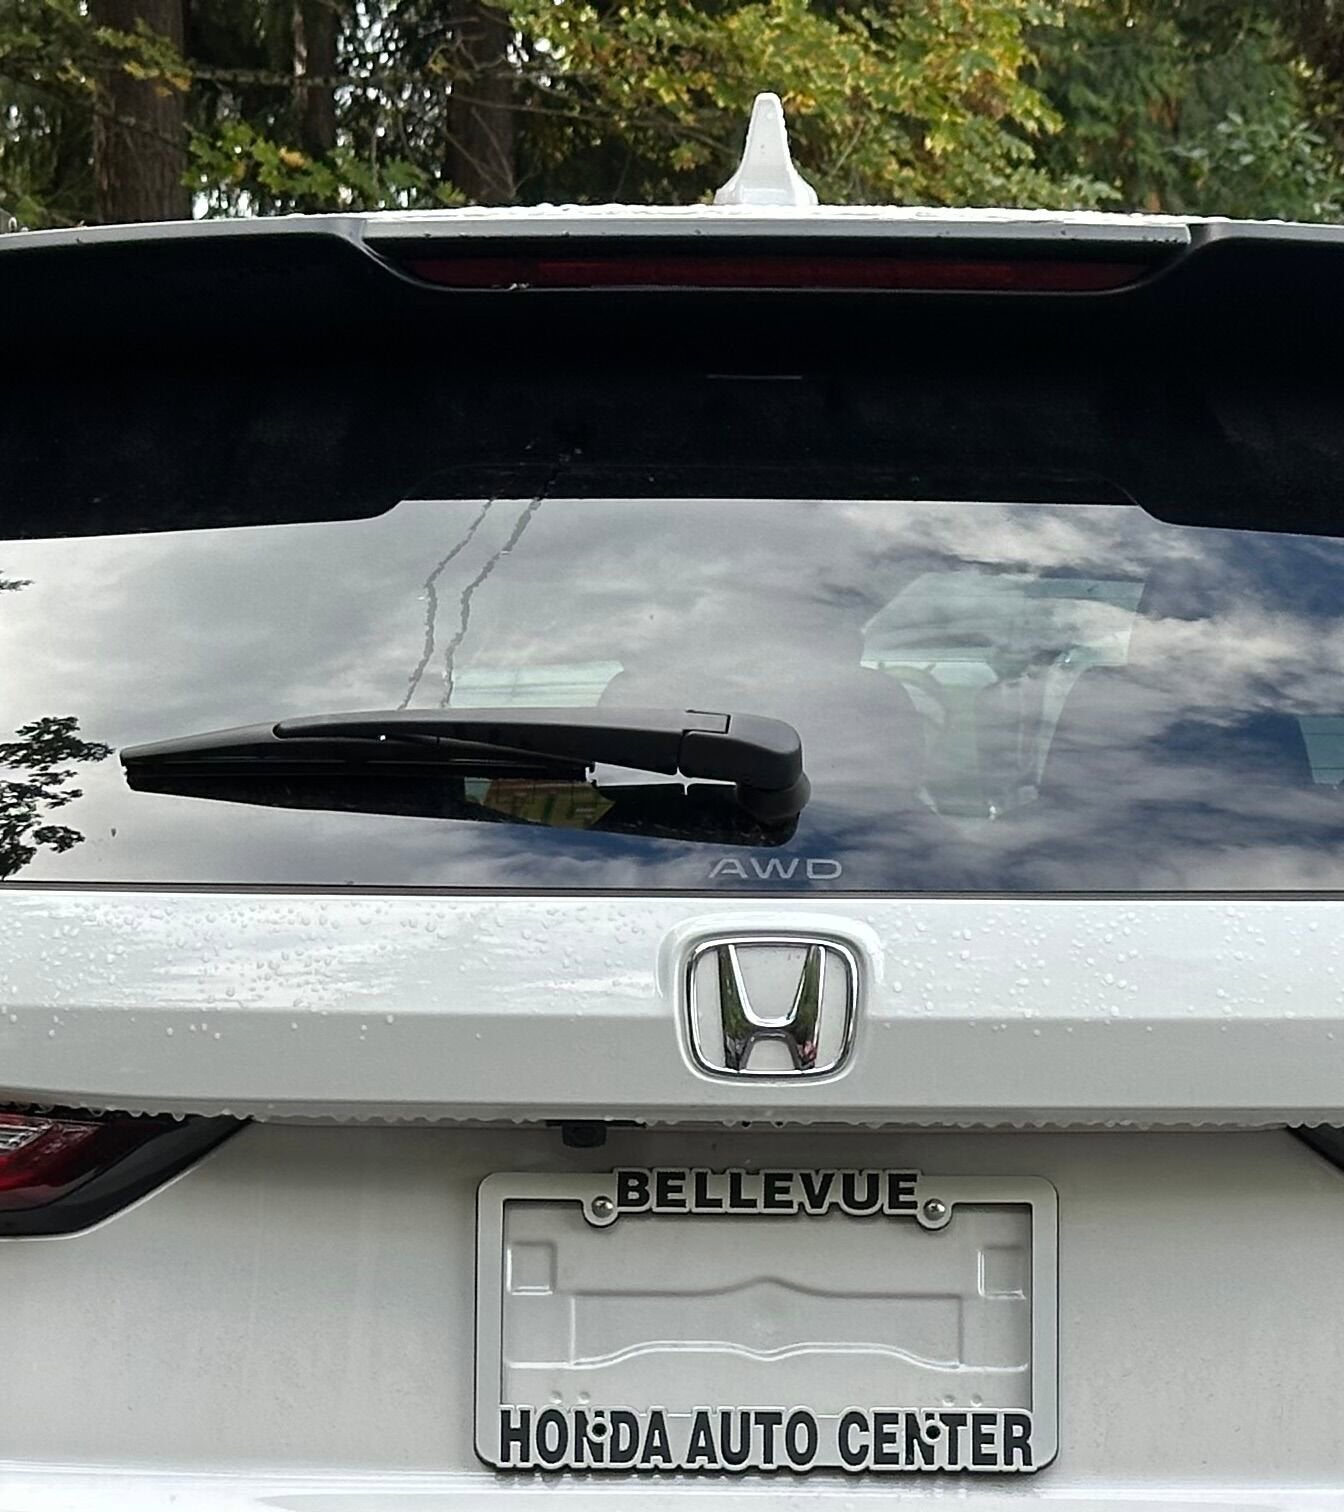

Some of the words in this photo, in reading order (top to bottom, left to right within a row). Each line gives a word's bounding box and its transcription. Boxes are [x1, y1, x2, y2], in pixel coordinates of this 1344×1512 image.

[708, 858, 843, 879] AWD
[616, 1171, 919, 1209] BELLEVUE
[499, 1409, 671, 1466] HONDA
[686, 1411, 819, 1466] AUTO
[837, 1411, 1034, 1467] CENTER
